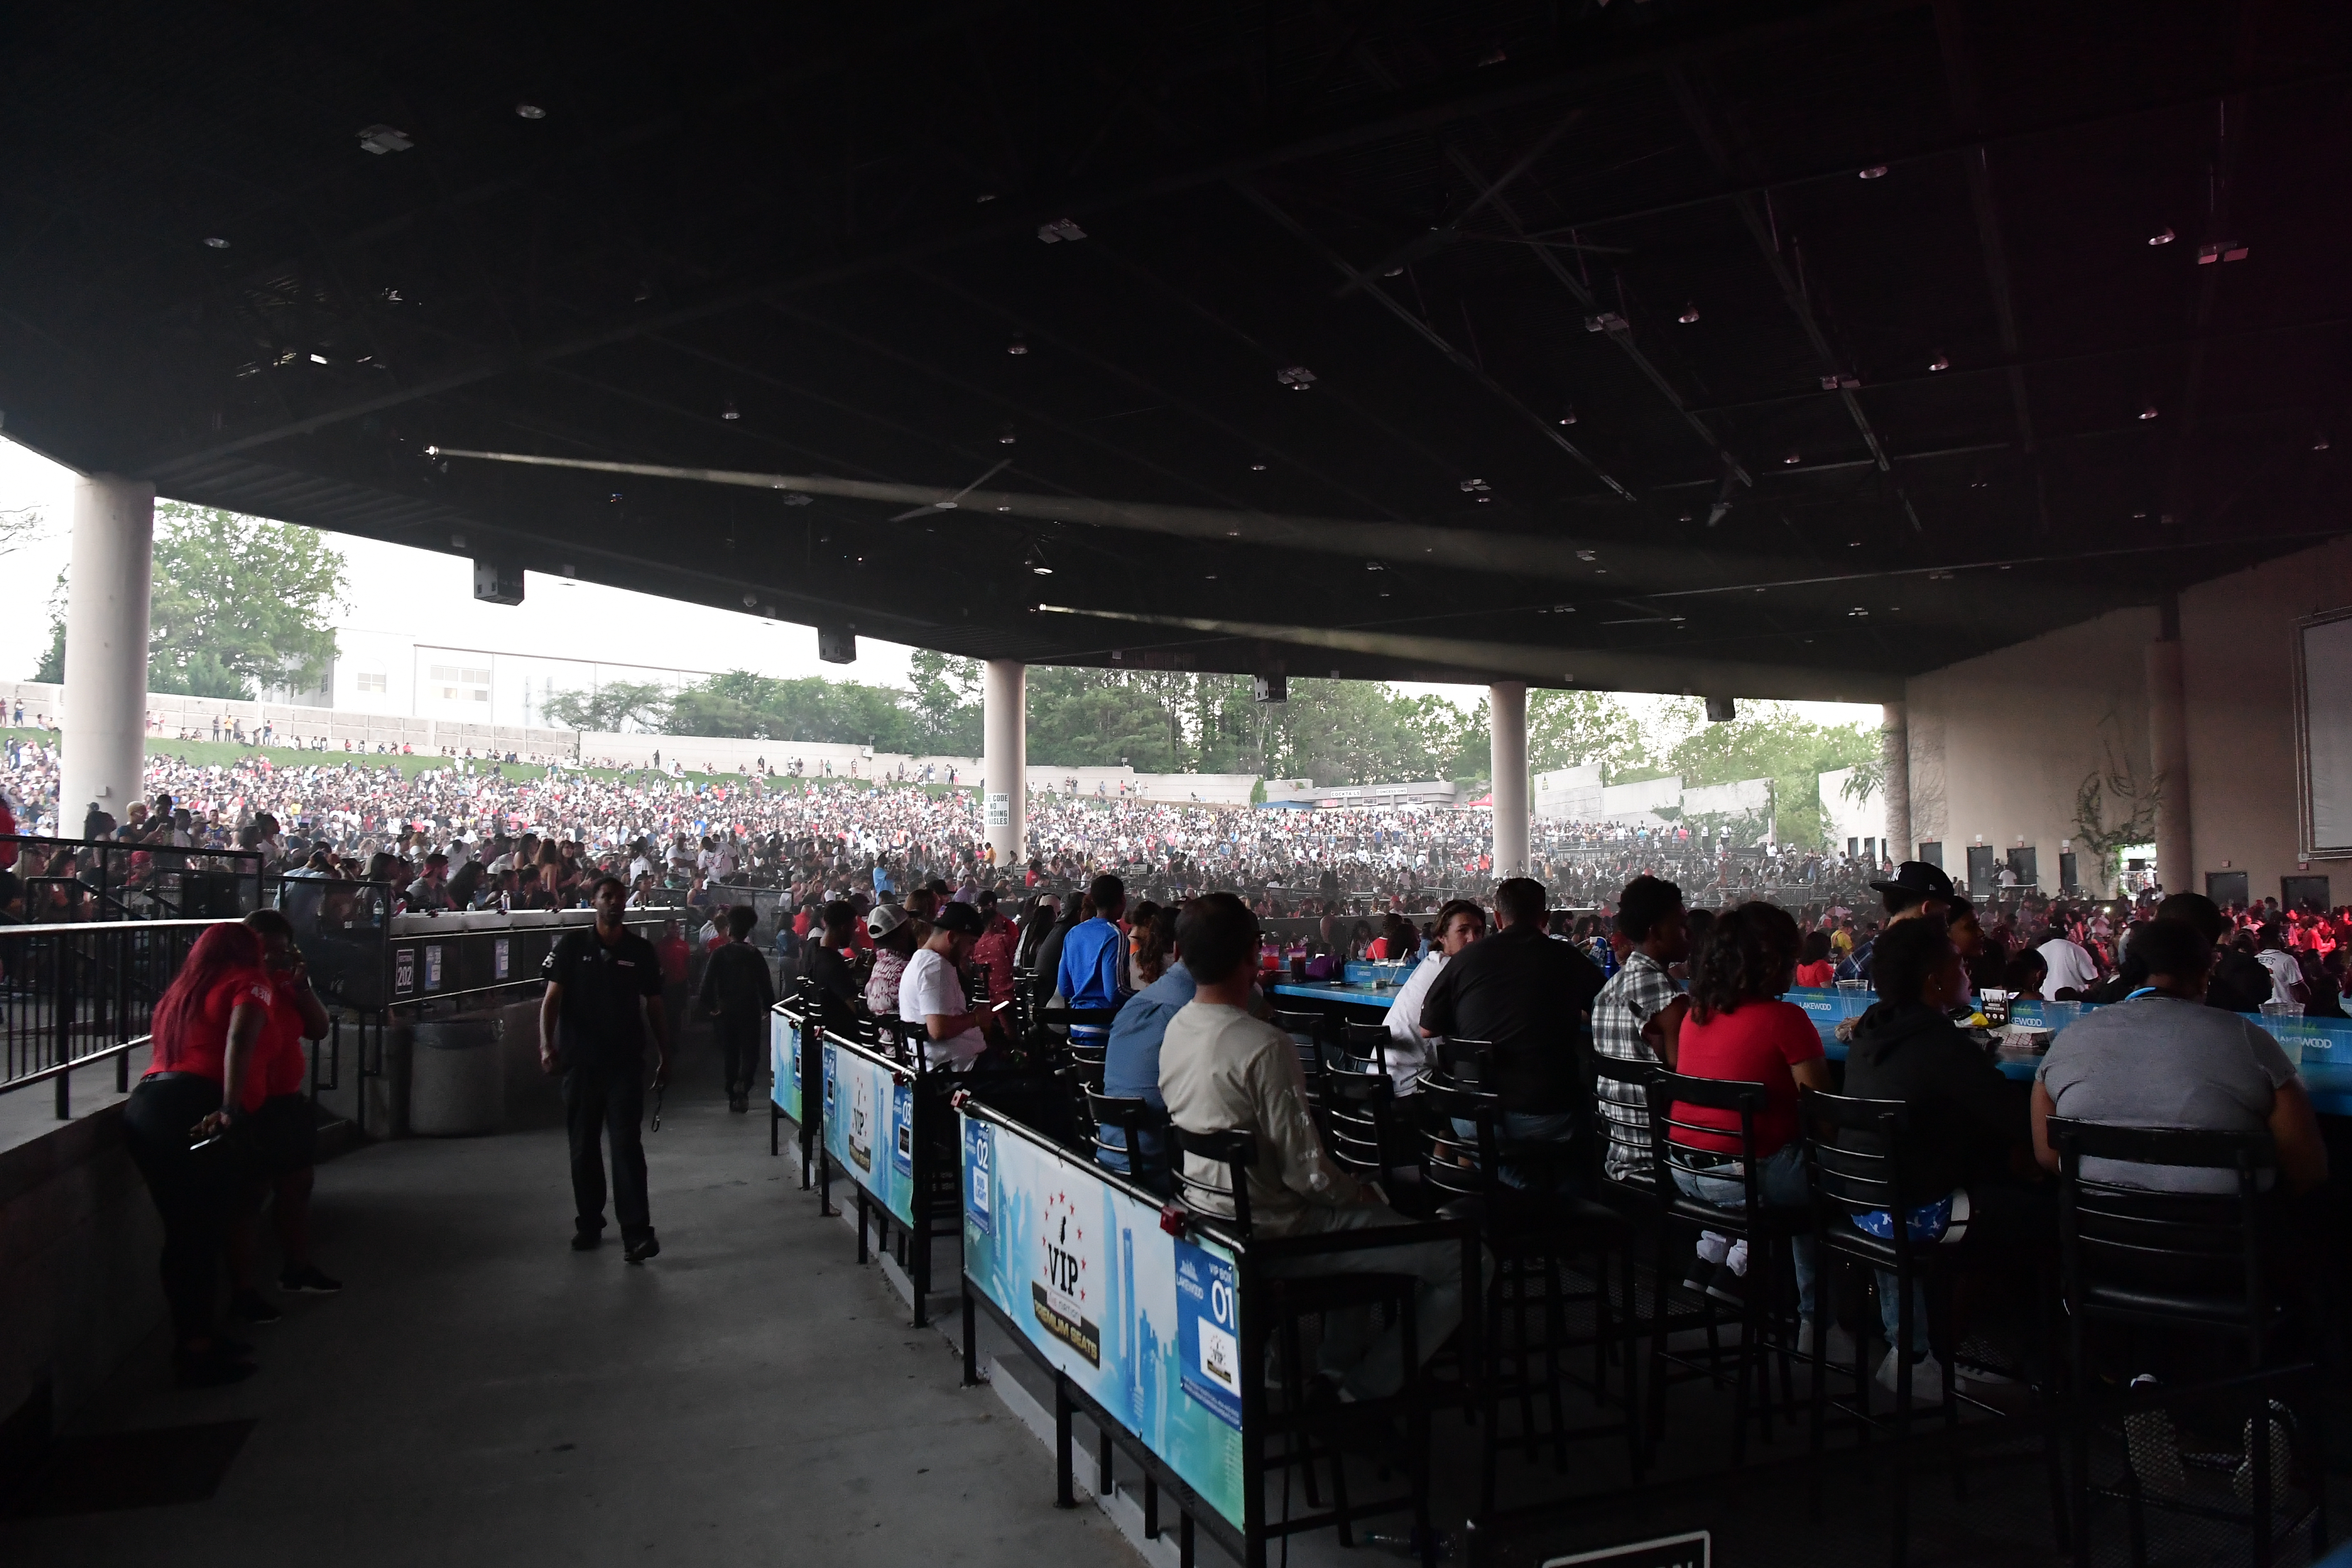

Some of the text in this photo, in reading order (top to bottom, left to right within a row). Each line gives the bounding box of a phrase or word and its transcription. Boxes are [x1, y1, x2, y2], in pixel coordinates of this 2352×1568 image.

[397, 966, 412, 986] 202
[1799, 1002, 1832, 1010] LAKEWOOD
[2010, 1017, 2042, 1026] KEWOOD
[854, 1107, 864, 1136] VIP
[902, 1100, 912, 1125] 03
[977, 1138, 988, 1170] 02
[1048, 1243, 1078, 1296] VIP
[1211, 1279, 1235, 1330] 01
[1034, 1298, 1098, 1360] PREMIUM SEATS
